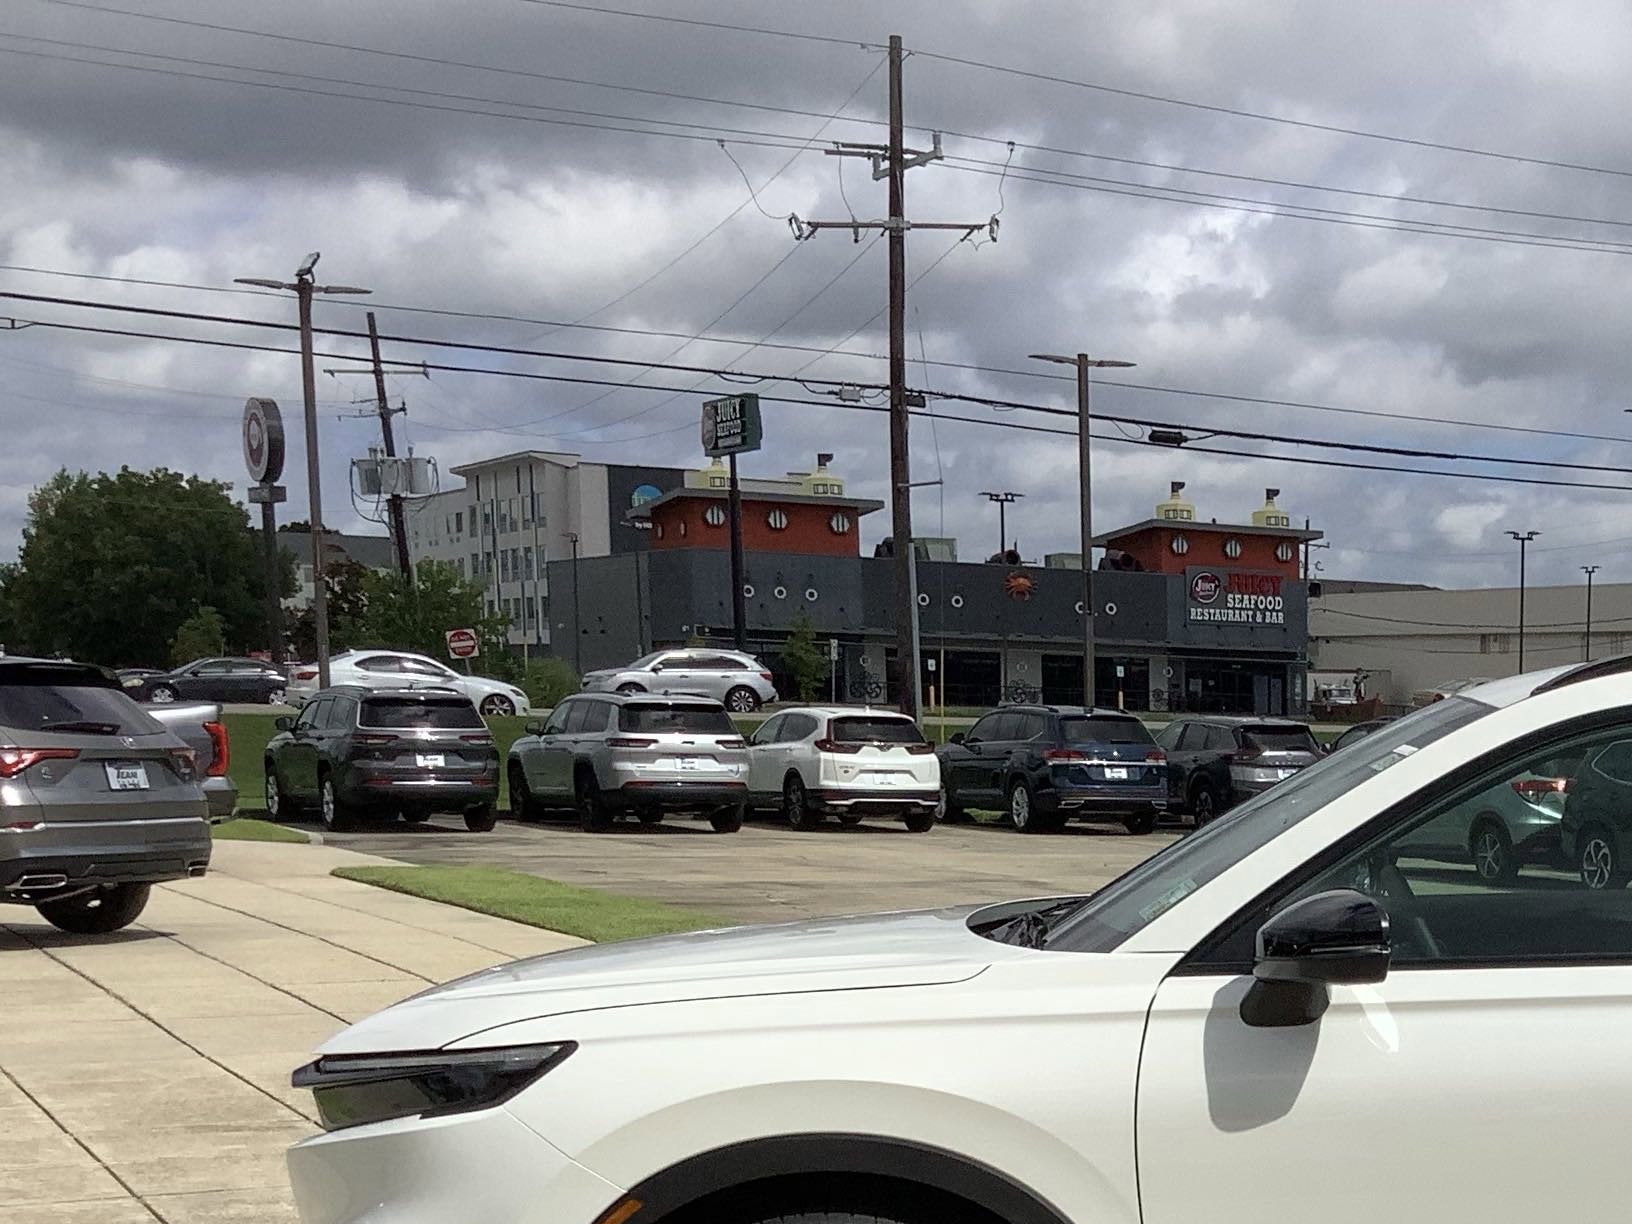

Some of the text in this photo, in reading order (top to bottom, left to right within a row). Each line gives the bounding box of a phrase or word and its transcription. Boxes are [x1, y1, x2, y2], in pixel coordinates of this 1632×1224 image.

[716, 399, 742, 422] JUICY
[1227, 594, 1283, 610] SEAFOOD
[1190, 607, 1284, 624] RESTAURANT & BAR
